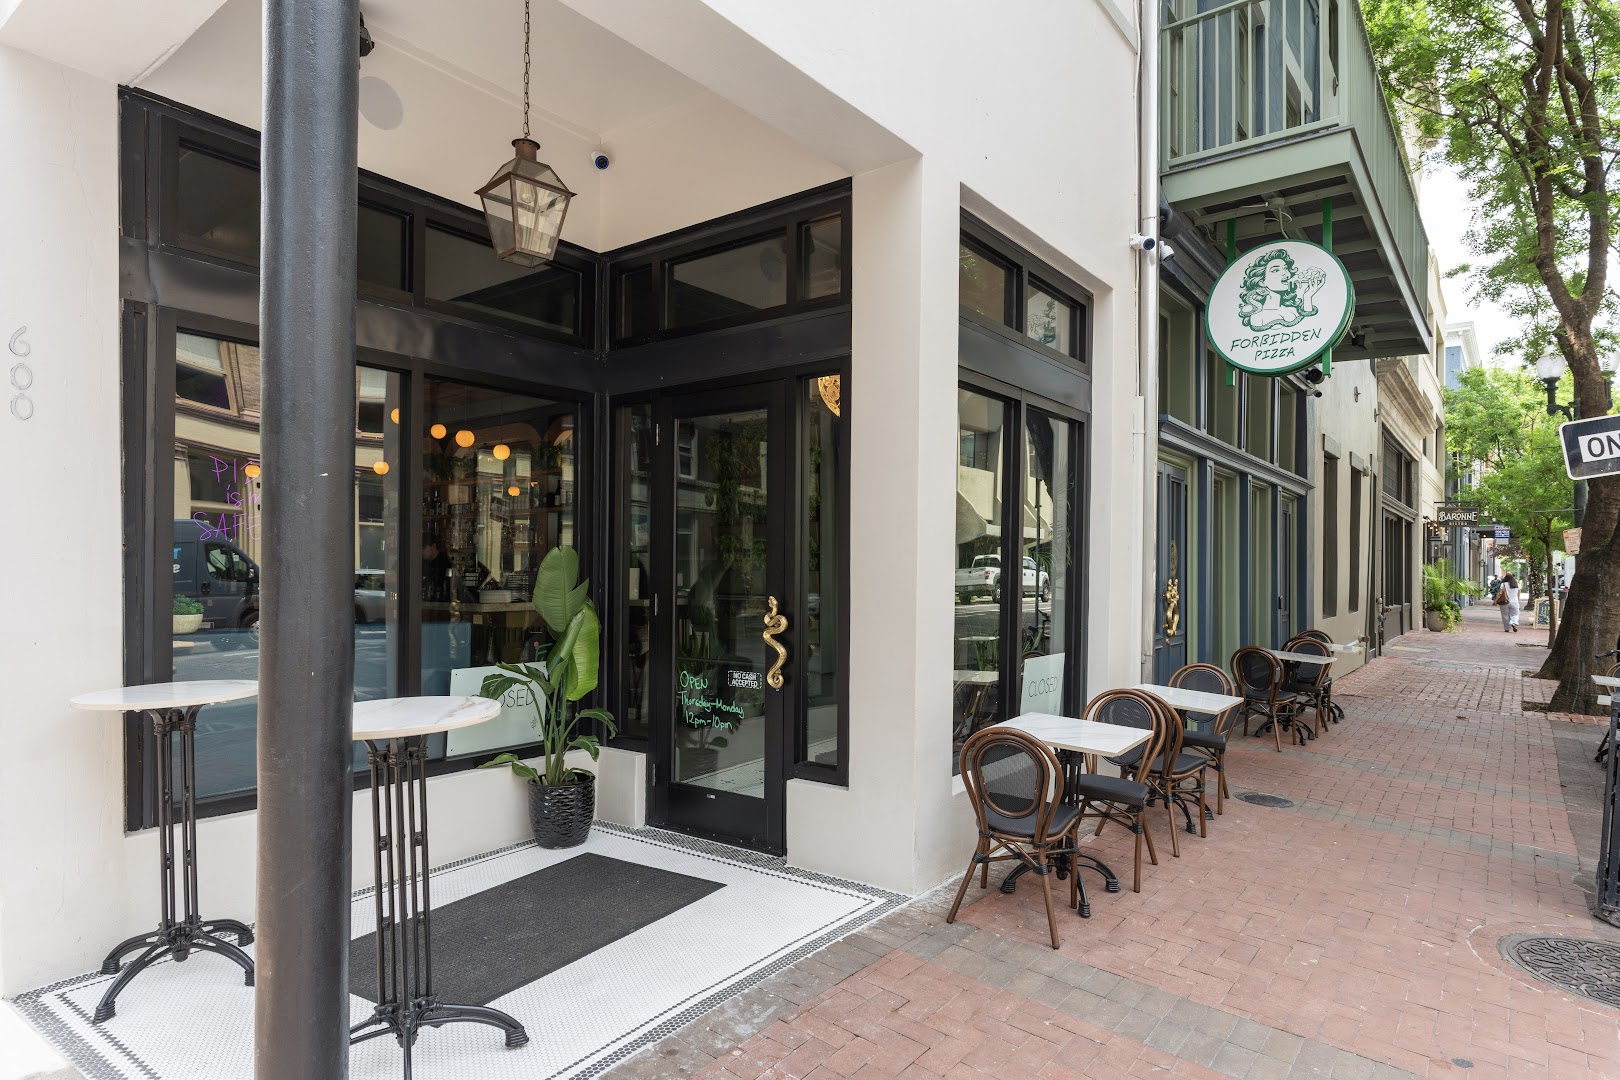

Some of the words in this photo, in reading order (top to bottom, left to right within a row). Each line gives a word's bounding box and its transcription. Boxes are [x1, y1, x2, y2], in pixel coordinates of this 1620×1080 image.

[1231, 328, 1322, 351] FORBIDDEN
[1254, 346, 1295, 361] PIZZA
[9, 325, 34, 420] 600
[1587, 433, 1620, 458] ON
[226, 483, 244, 508] is
[1438, 511, 1478, 522] BARONNE
[680, 670, 708, 690] OPEN
[732, 679, 758, 688] ACCEPTED
[733, 672, 741, 680] NO
[742, 672, 757, 681] CASH
[1028, 676, 1059, 698] CLOSED
